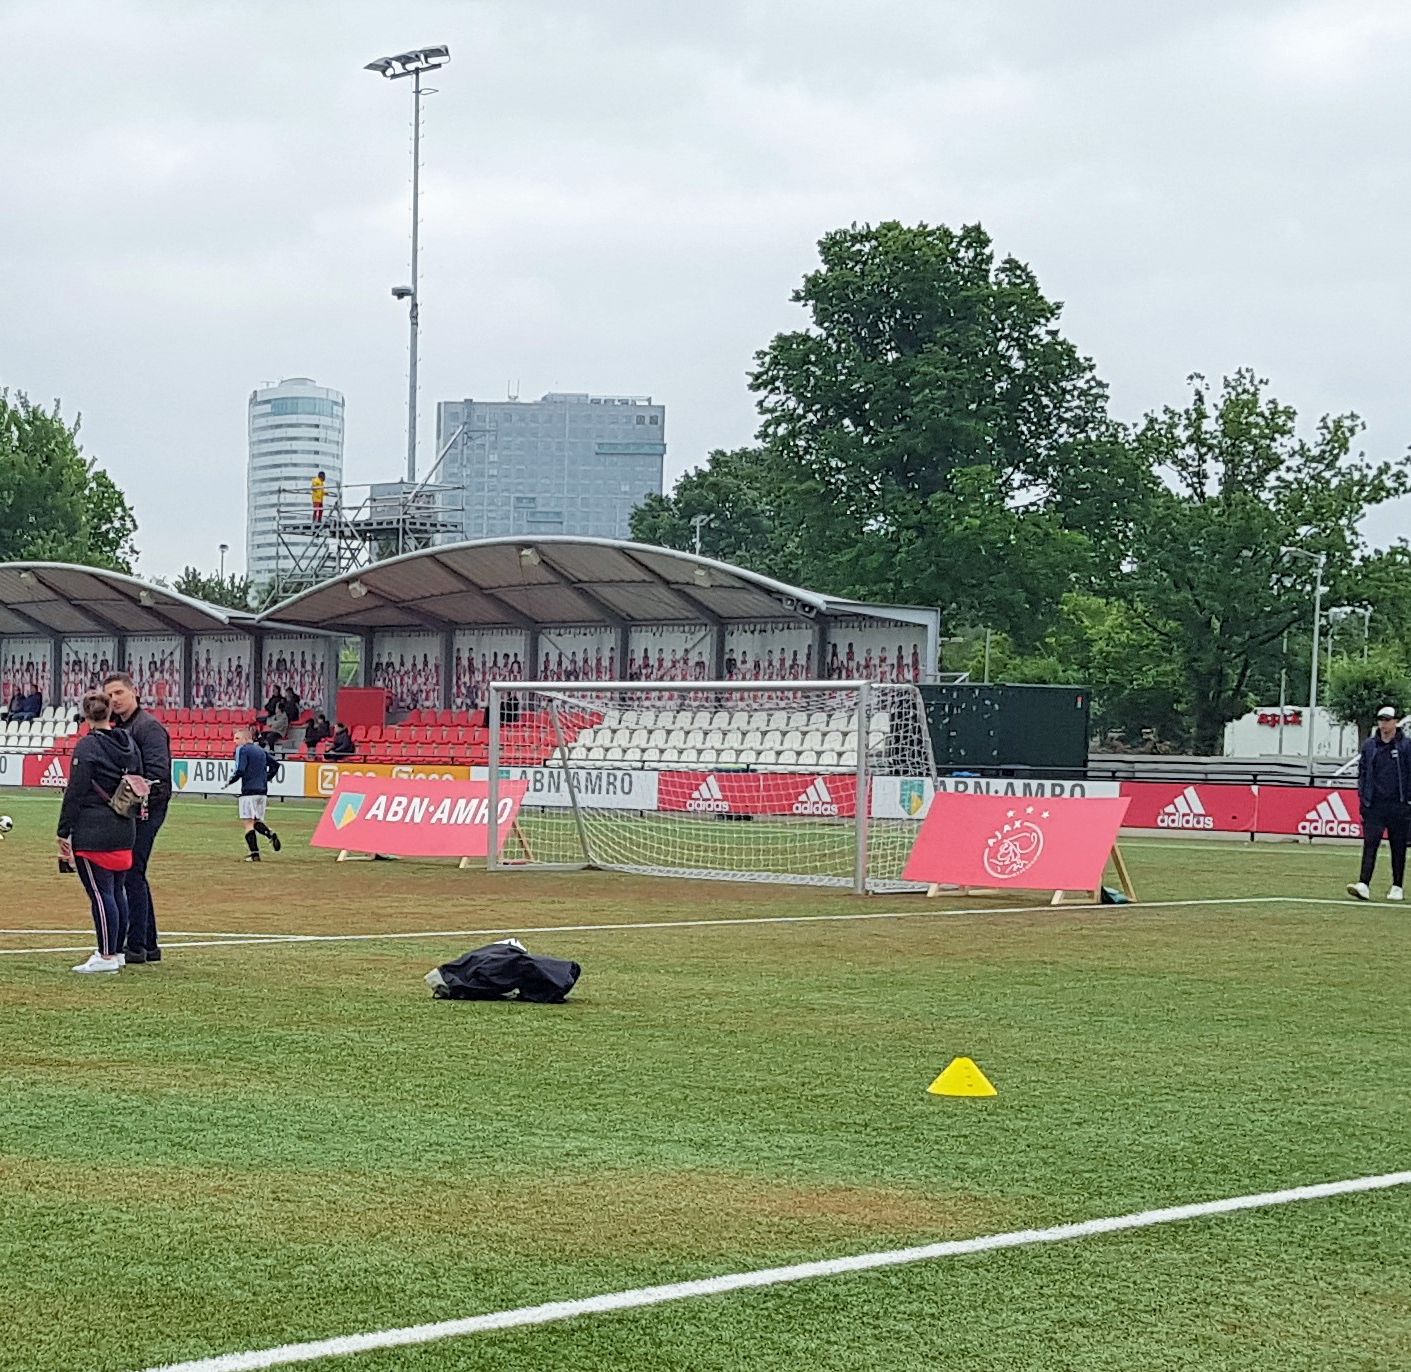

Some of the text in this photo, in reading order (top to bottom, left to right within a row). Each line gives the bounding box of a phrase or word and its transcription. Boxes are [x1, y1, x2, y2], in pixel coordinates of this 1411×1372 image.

[686, 798, 730, 812] adidas
[793, 799, 839, 815] adidas
[1156, 812, 1214, 829] adidas
[1297, 819, 1361, 836] adidas
[987, 820, 1022, 847] AJAX
